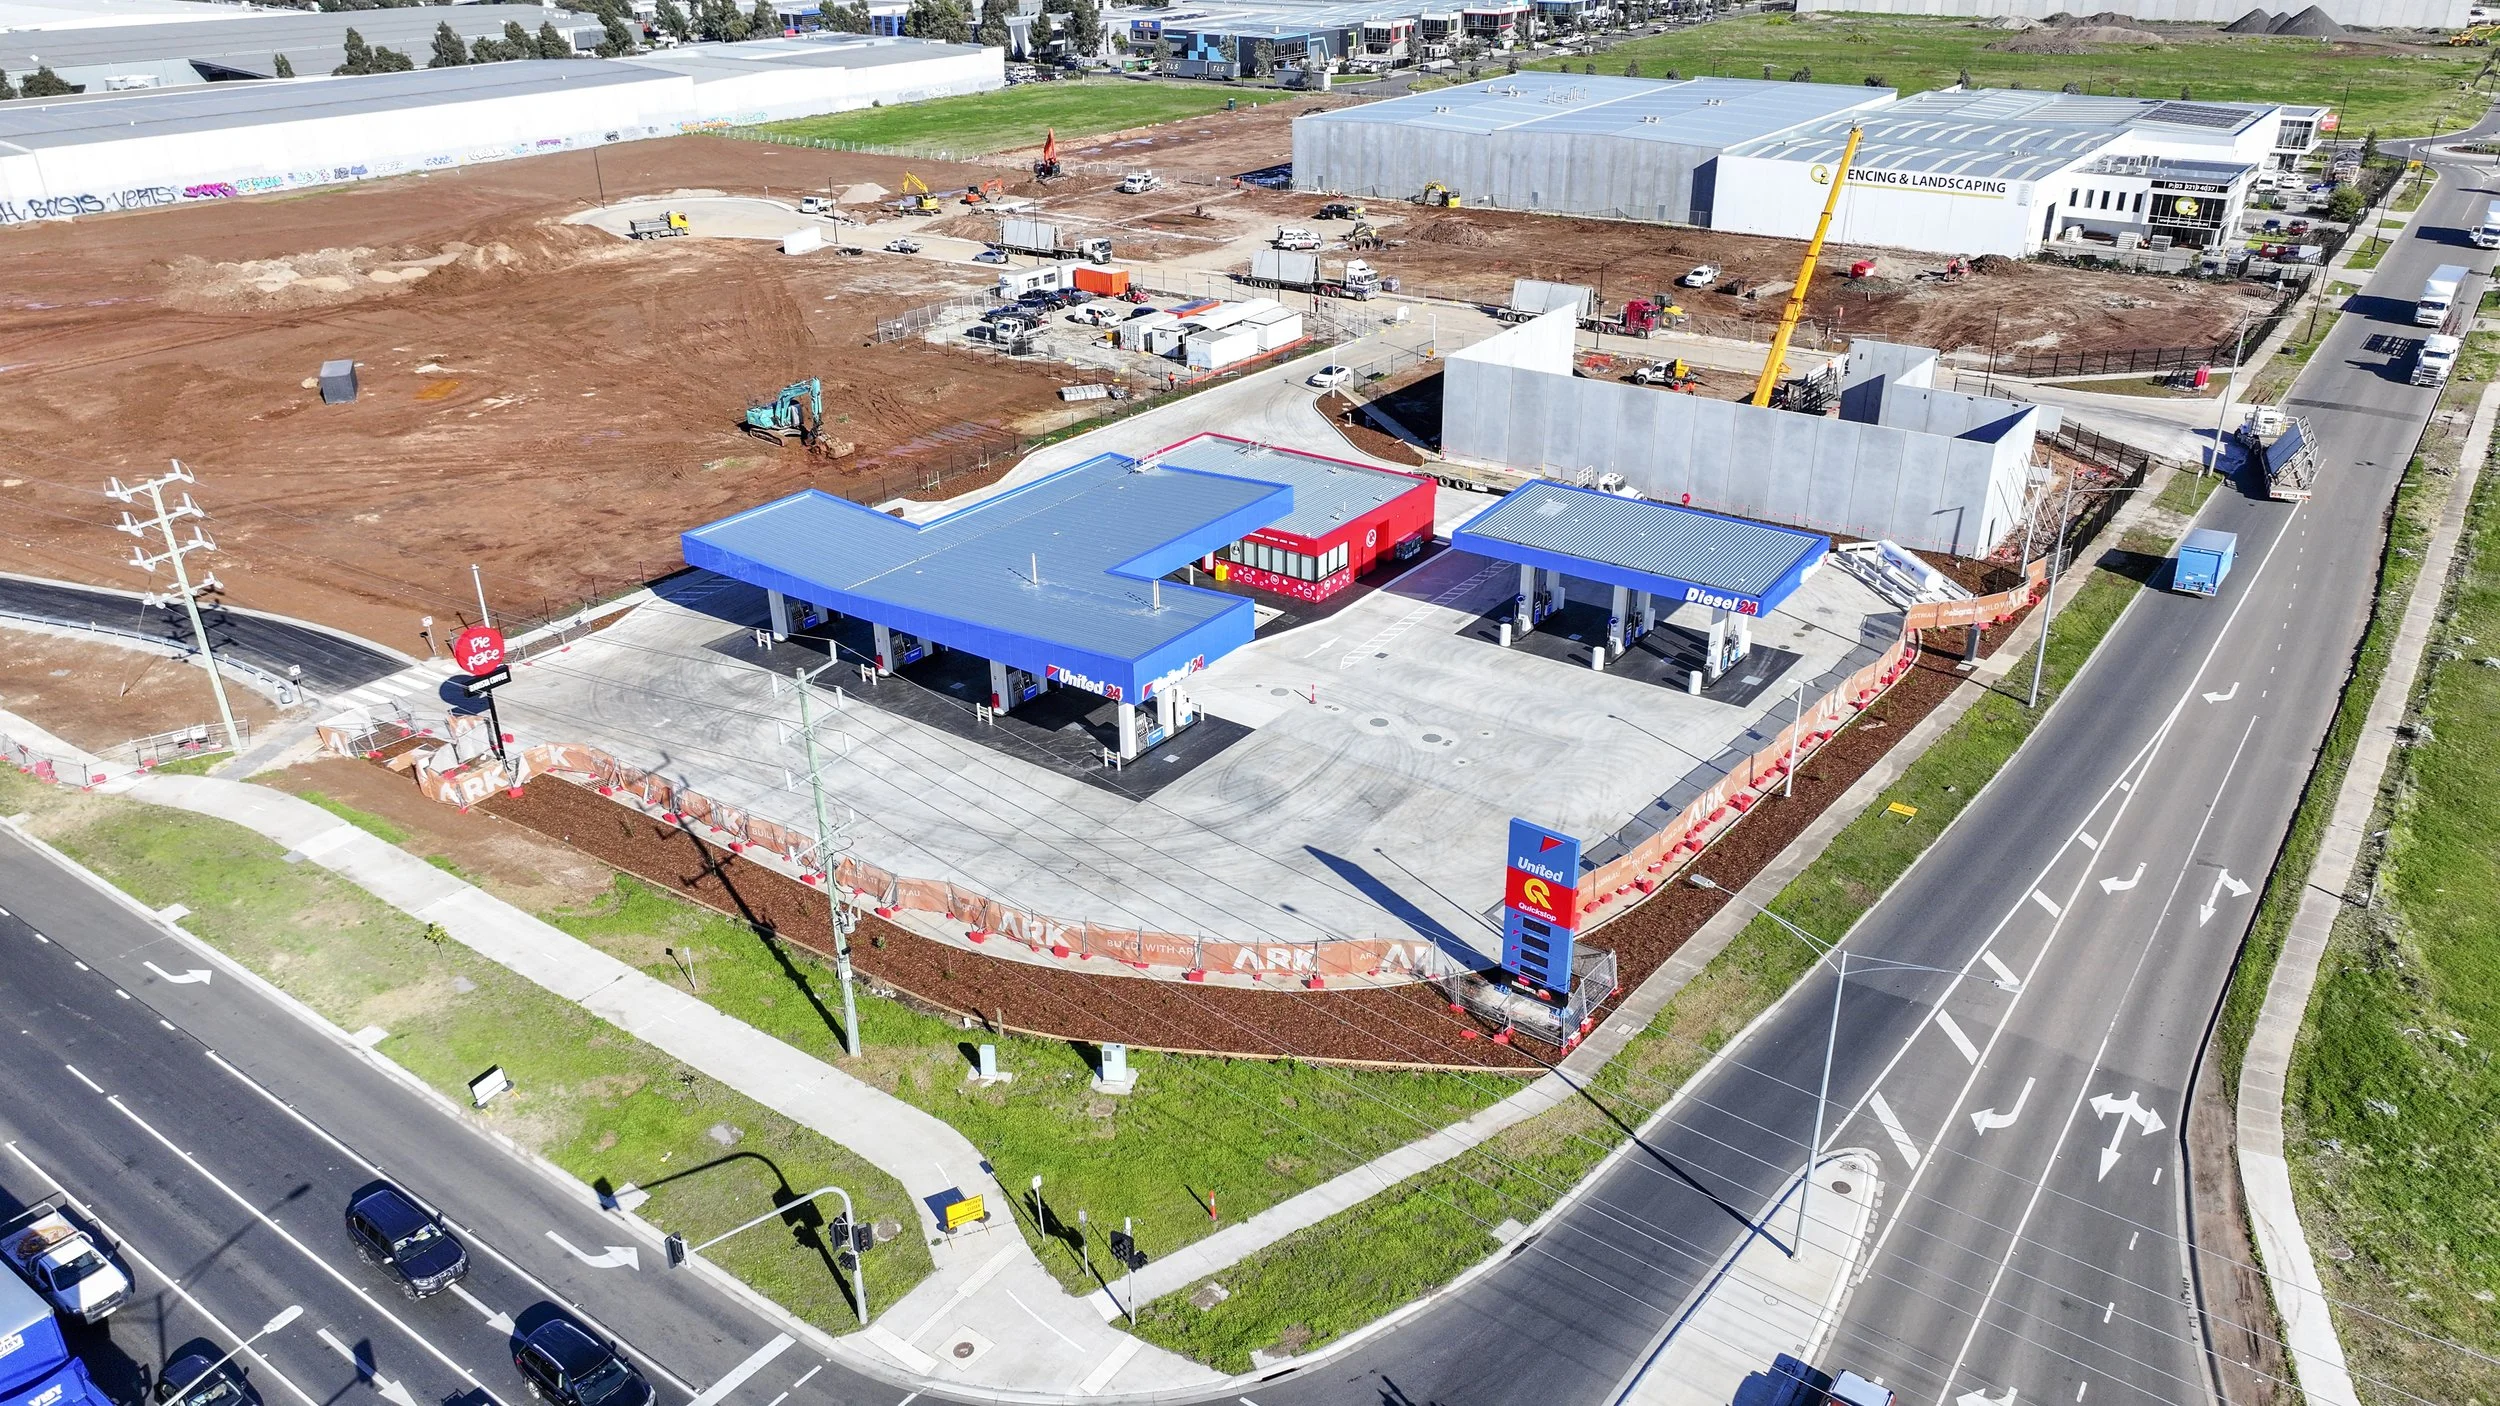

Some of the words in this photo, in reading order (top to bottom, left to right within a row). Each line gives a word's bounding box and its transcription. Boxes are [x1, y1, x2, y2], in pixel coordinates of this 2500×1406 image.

[1165, 62, 1180, 71] TLS
[1212, 64, 1227, 73] TLS
[1846, 168, 1897, 184] ENCING
[1899, 173, 1909, 185] &
[1911, 175, 2007, 193] LANDSCAPING
[1685, 587, 1739, 611] Diesel
[1737, 599, 1758, 615] 24
[470, 636, 491, 653] Pie
[1190, 654, 1205, 673] 24
[1058, 667, 1105, 695] United
[1105, 683, 1123, 701] 24
[1517, 856, 1564, 883] United
[1518, 901, 1557, 922] Quickstop
[999, 910, 1069, 946] ARK
[1232, 945, 1321, 972] ARK
